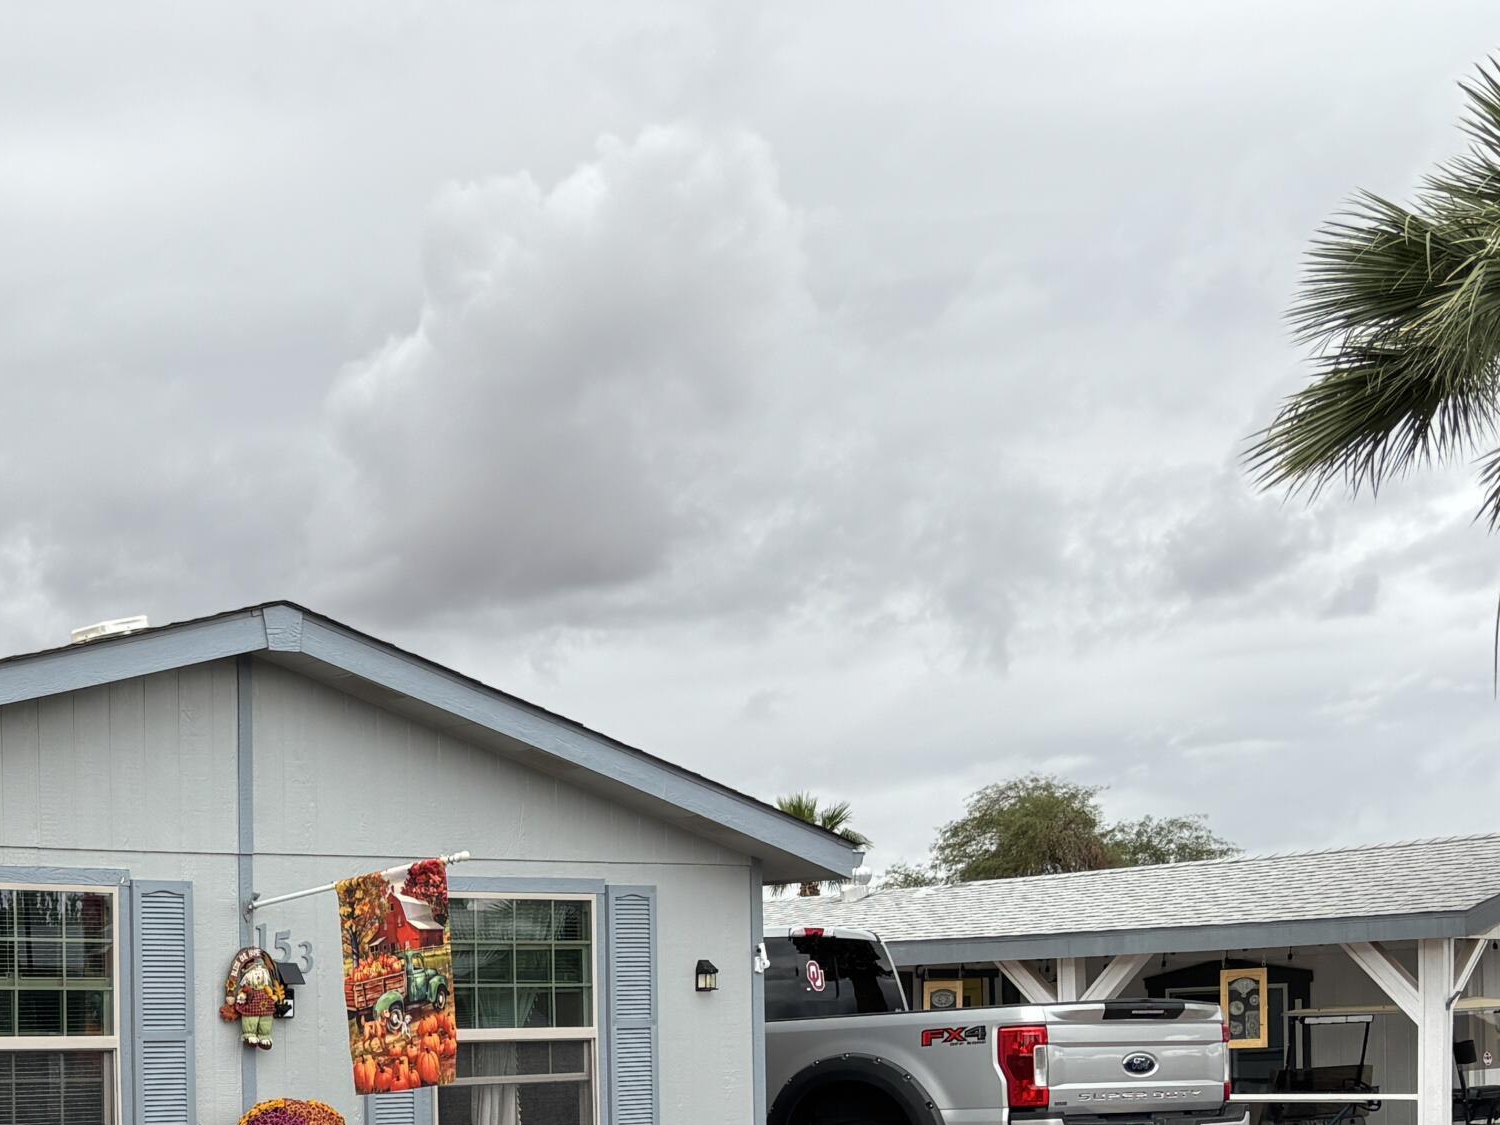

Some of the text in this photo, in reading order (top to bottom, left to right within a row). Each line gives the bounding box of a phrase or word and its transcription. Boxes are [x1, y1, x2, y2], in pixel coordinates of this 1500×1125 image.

[255, 923, 314, 974] 153
[921, 1025, 986, 1047] FX4
[1078, 1089, 1202, 1102] SUPER DUTY
